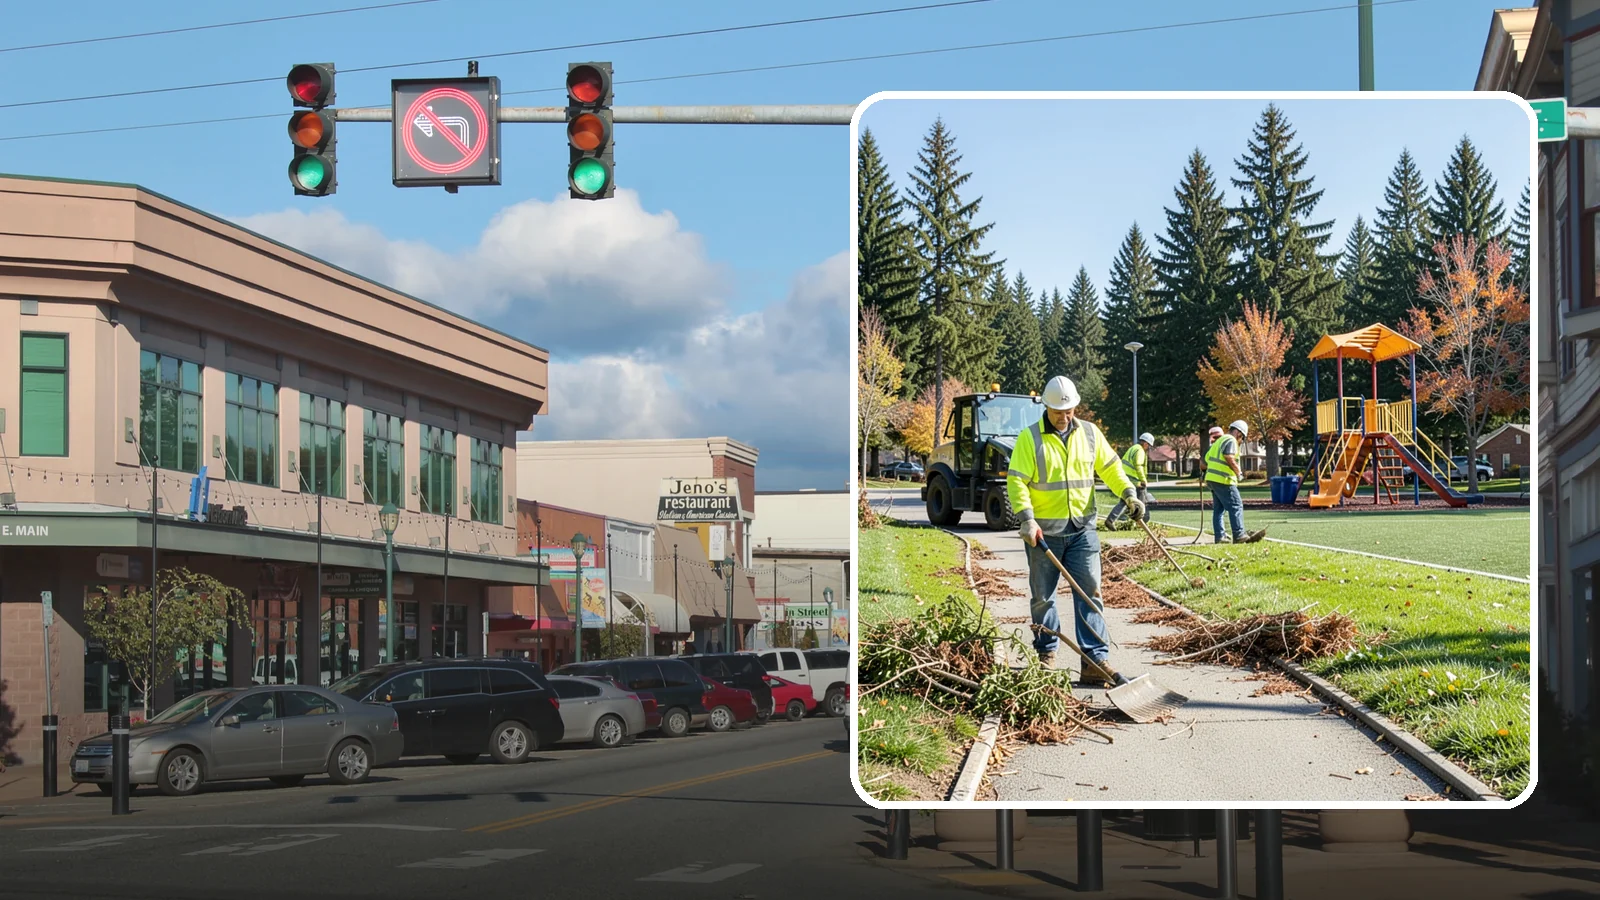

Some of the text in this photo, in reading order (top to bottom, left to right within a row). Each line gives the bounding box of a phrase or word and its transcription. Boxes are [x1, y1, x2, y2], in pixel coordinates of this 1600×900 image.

[669, 480, 727, 494] Jeno's
[665, 496, 731, 509] restaurant
[658, 510, 682, 520] Italian
[686, 509, 715, 519] American
[714, 509, 738, 519] Cuisine
[2, 525, 49, 537] E. MAIN
[797, 607, 828, 616] Street
